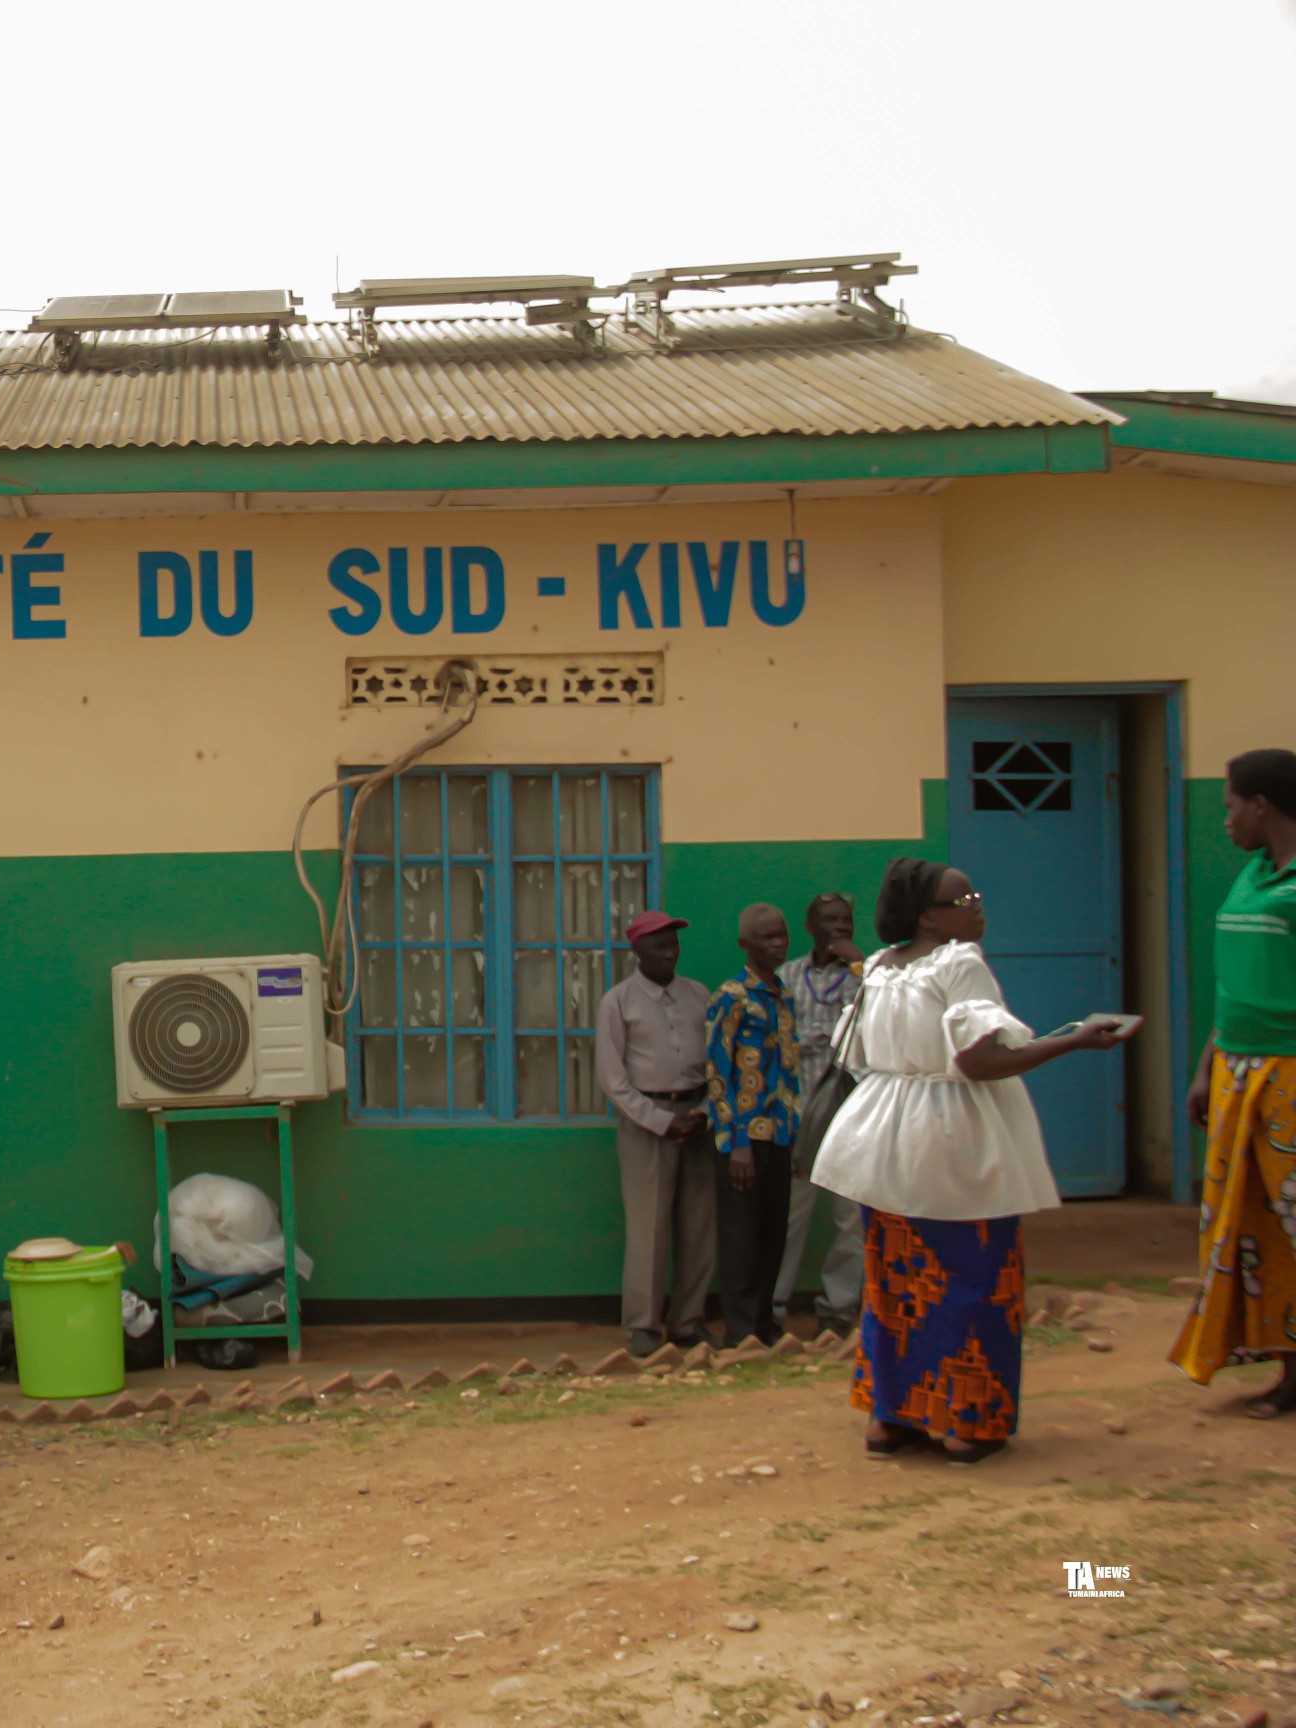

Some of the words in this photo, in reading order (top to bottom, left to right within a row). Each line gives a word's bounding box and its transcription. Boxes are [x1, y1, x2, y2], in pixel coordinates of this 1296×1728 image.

[138, 549, 254, 638] DU
[327, 546, 506, 636] SUD
[597, 539, 806, 630] KIVU
